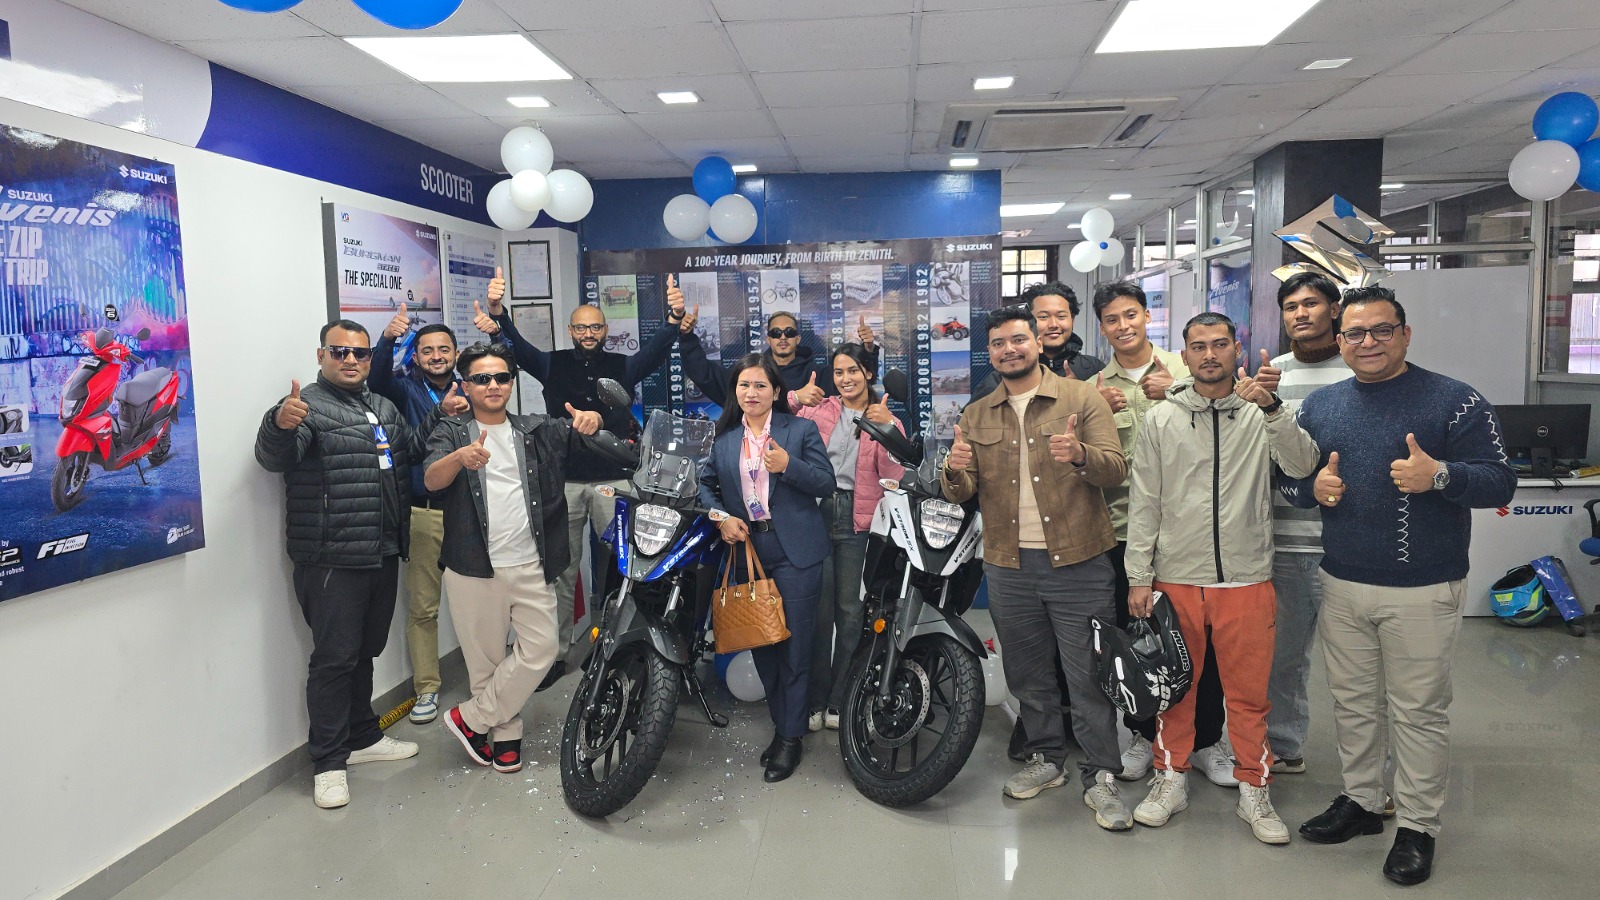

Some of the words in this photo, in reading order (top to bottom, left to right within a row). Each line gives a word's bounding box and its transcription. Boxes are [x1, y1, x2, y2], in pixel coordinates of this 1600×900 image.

[130, 169, 168, 185] SUZUKI
[421, 163, 475, 205] SCOOTER
[8, 189, 53, 203] SUZUKI
[0, 202, 117, 227] venis
[9, 225, 43, 258] ZIP
[343, 237, 363, 246] SUZUKI
[956, 243, 993, 251] SUZUKI
[343, 245, 401, 264] BURGMAN
[685, 256, 693, 268] A
[694, 254, 738, 267] 100-YEAR
[739, 252, 784, 266] JOURNEY,
[786, 251, 813, 264] FROM
[814, 250, 843, 262] BIRTH
[844, 249, 857, 261] TO
[858, 248, 895, 261] ZENITH.
[4, 258, 49, 286] TRIP
[345, 269, 359, 286] THE
[360, 272, 389, 289] SPECIAL
[389, 275, 403, 290] ONE
[748, 276, 760, 313] 1952
[830, 272, 843, 310] 1958
[916, 268, 929, 308] 1962
[1208, 279, 1240, 299] Avenis
[832, 317, 844, 351] 981
[917, 313, 930, 351] 1982
[669, 364, 683, 402] 1993
[918, 358, 931, 394] 2006
[1513, 505, 1573, 515] SUZUKI
[6, 566, 24, 576] robust
